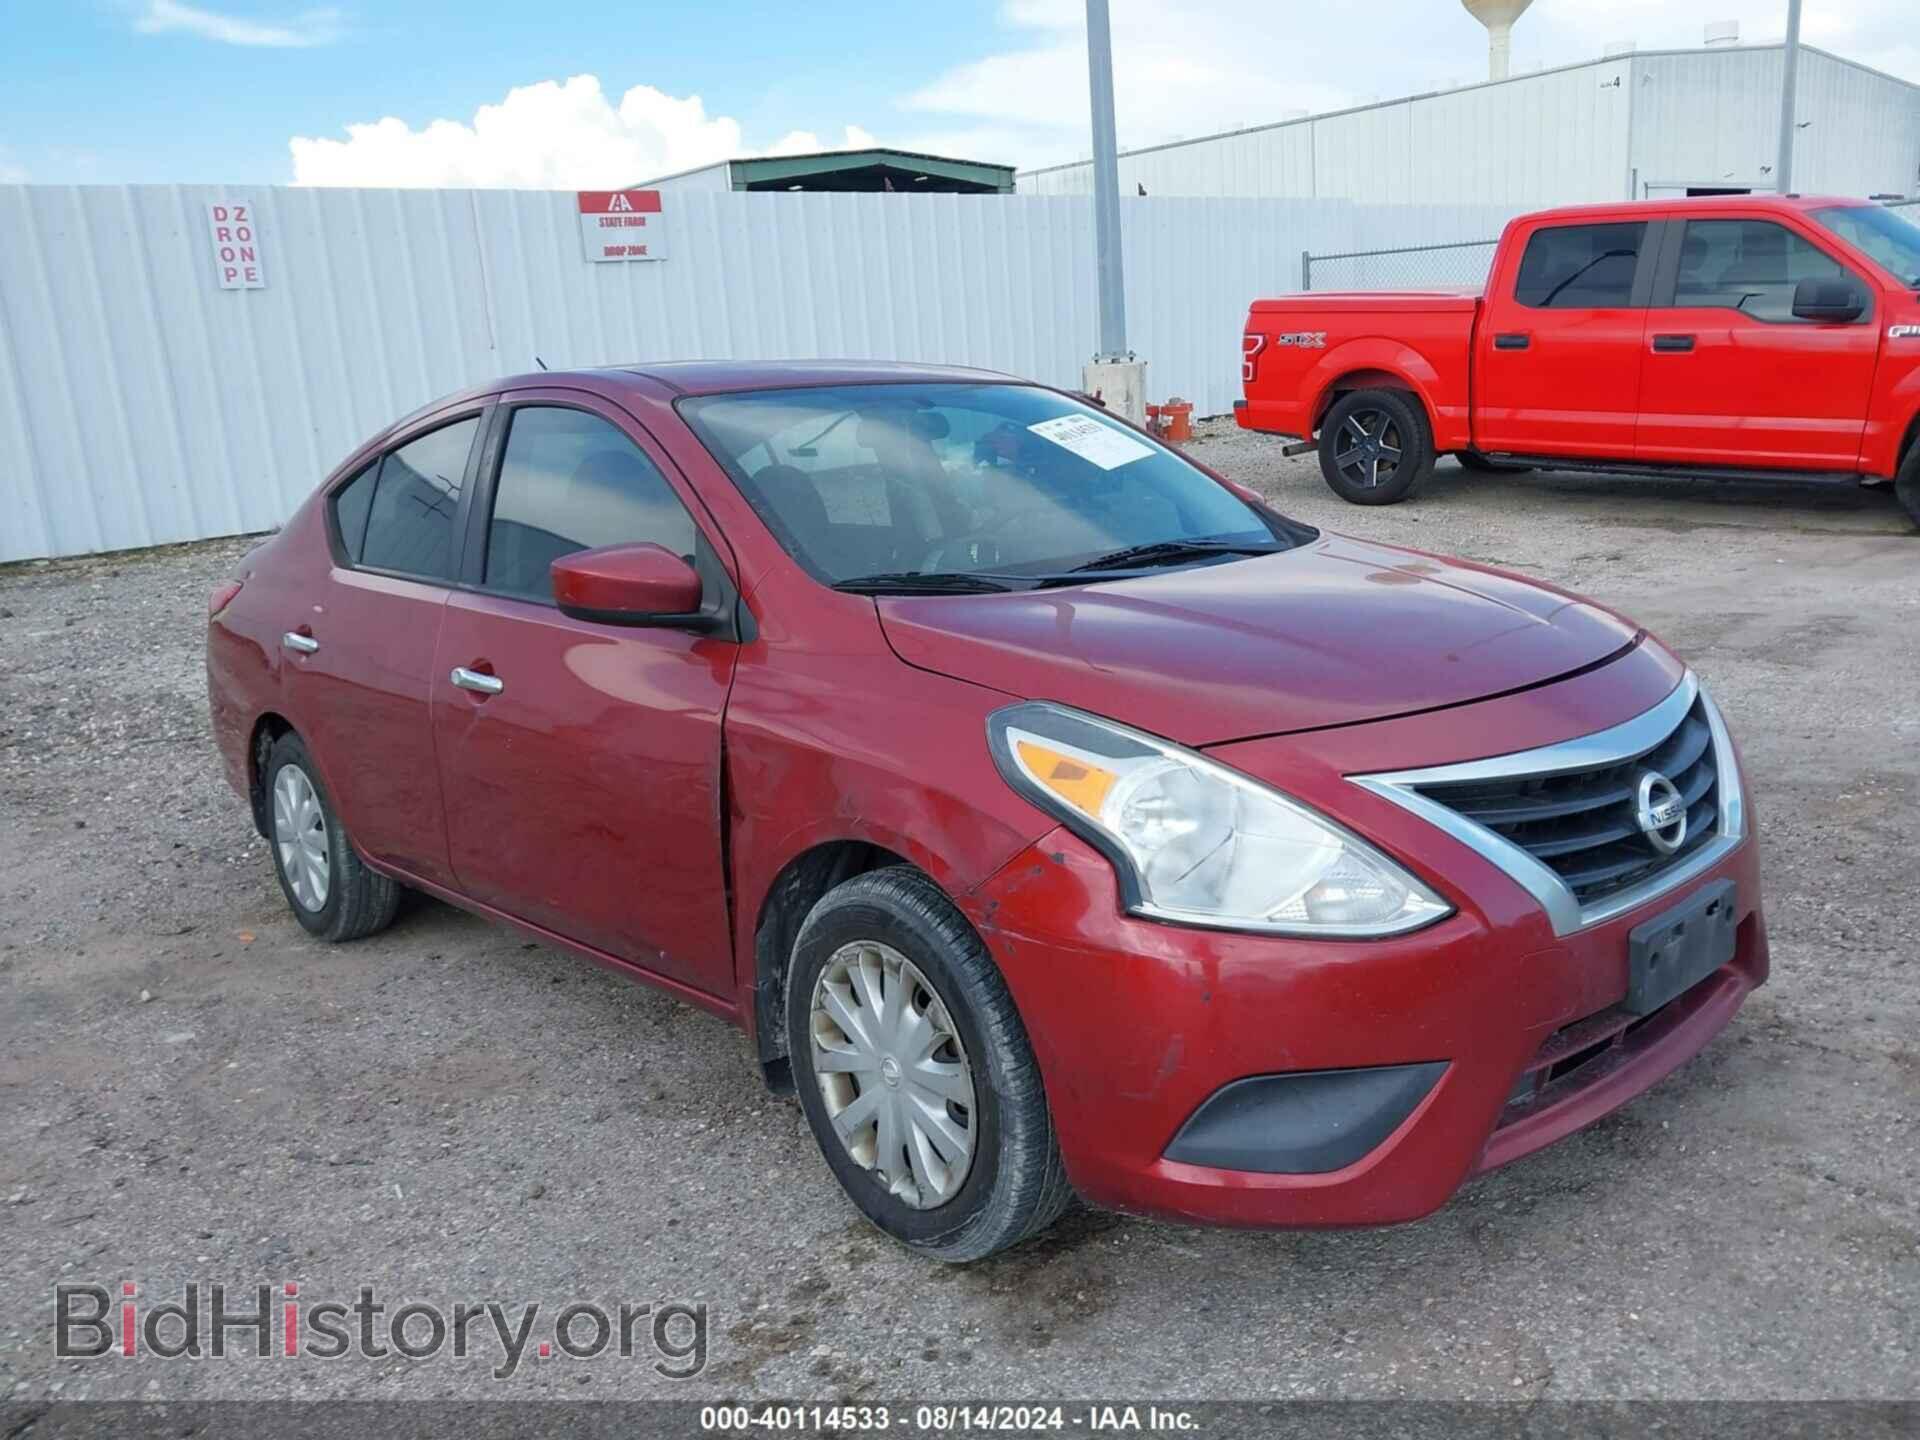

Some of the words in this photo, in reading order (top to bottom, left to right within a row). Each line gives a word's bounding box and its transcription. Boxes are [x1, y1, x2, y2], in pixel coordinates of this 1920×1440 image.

[599, 216, 623, 228] STATE
[624, 216, 646, 227] FARM
[212, 205, 238, 283] DROP
[232, 205, 258, 283] ZONE
[604, 246, 626, 257] DROP
[627, 245, 648, 256] ZONE
[1649, 801, 1682, 826] NISS
